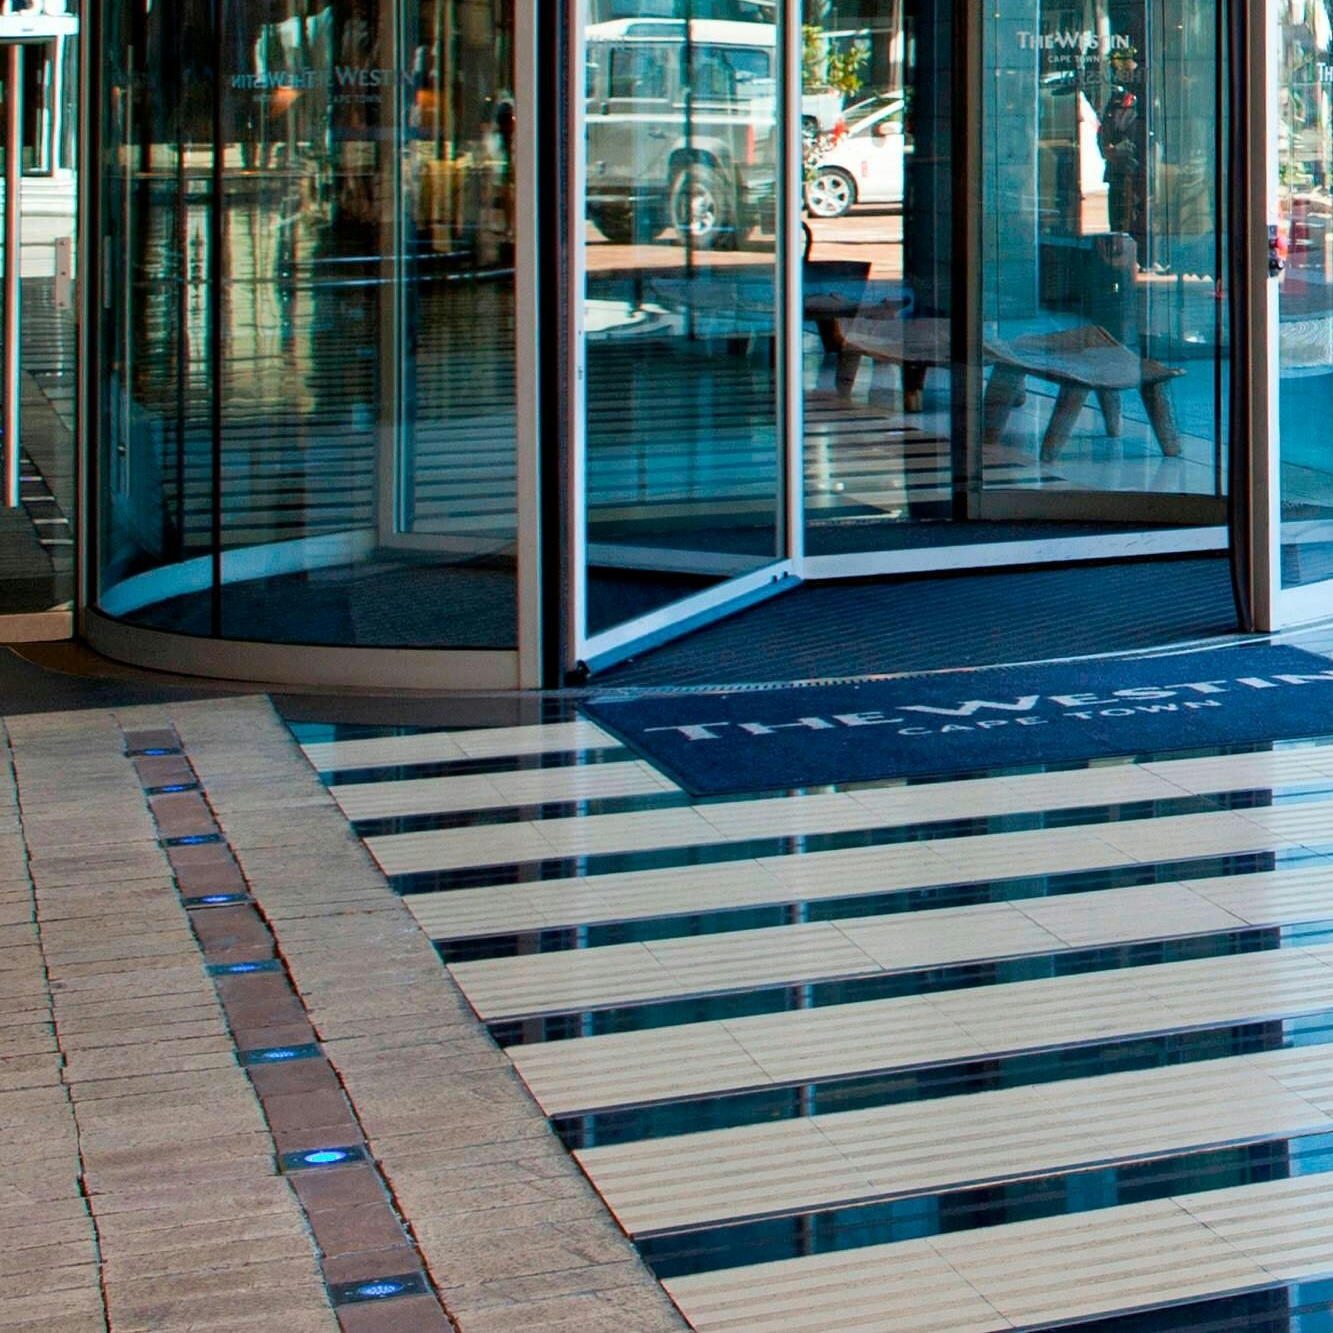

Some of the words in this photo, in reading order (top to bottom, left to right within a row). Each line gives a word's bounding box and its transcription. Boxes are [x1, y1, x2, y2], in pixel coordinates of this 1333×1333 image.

[1017, 31, 1055, 49] THE
[643, 711, 904, 741] THE
[897, 716, 1049, 736] CAPE
[1063, 699, 1222, 720] TOWN
